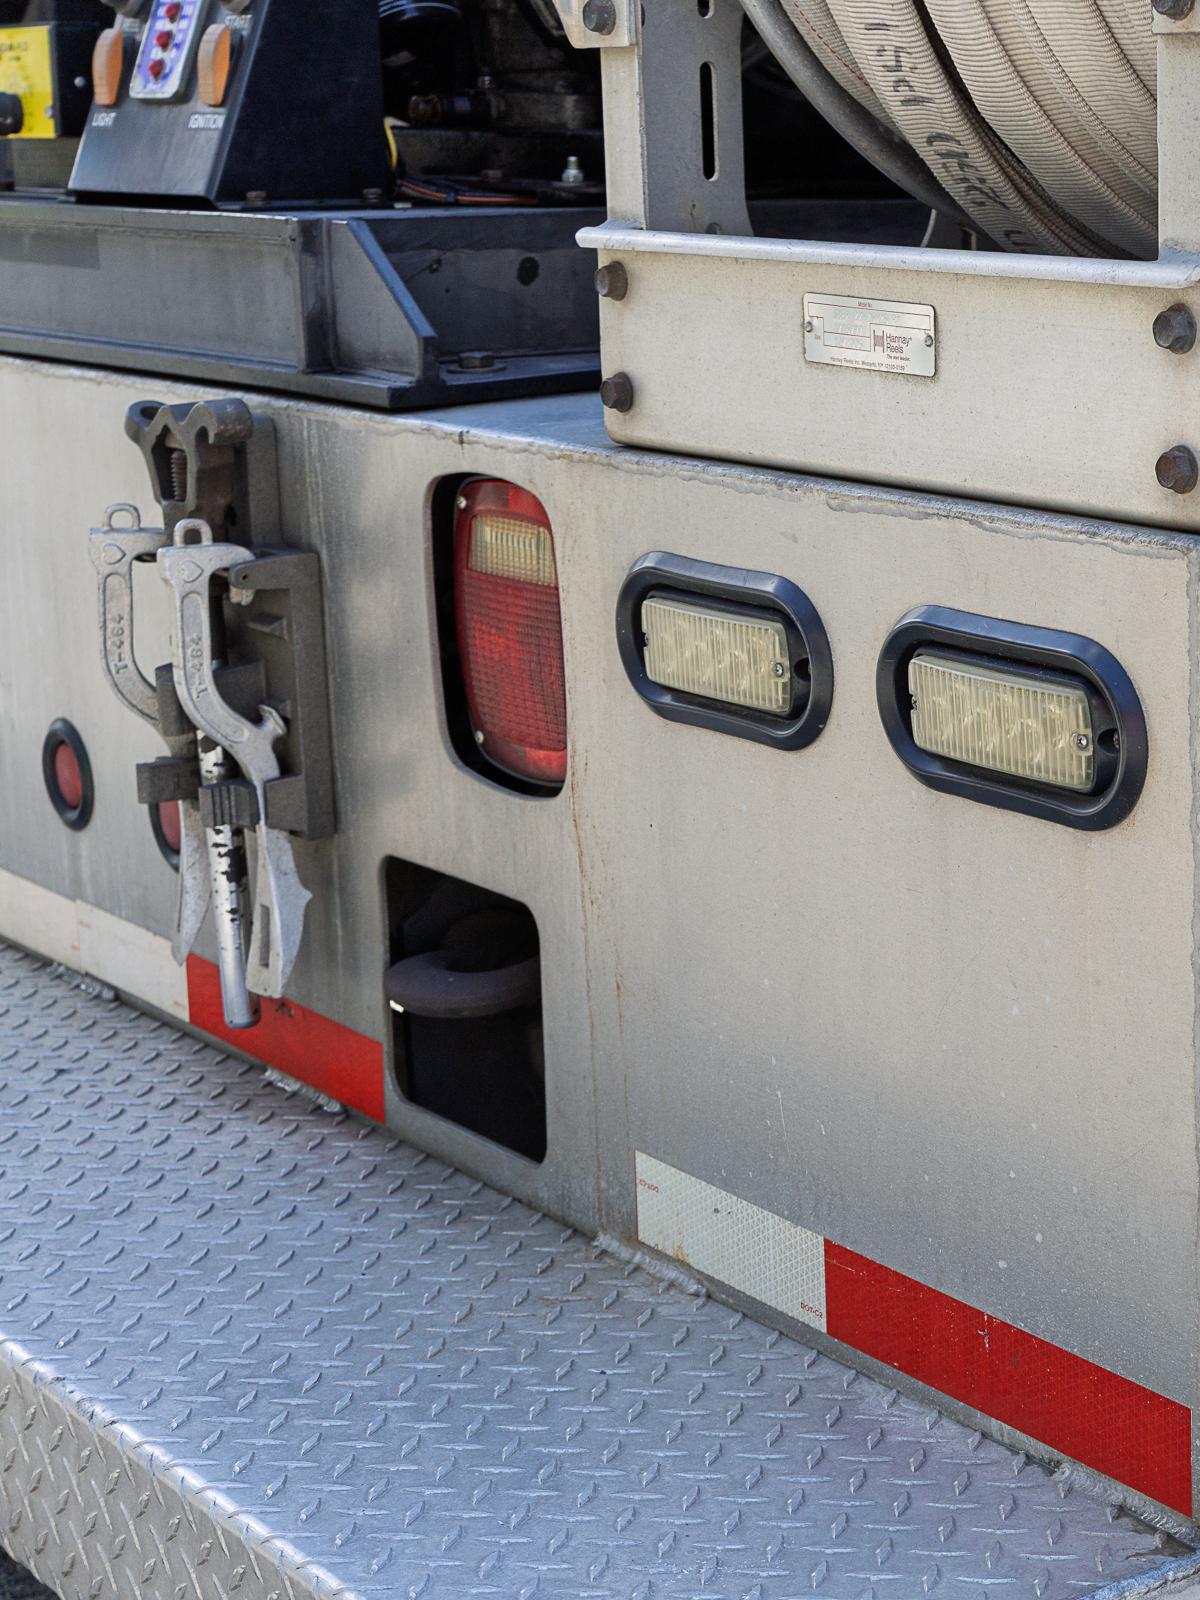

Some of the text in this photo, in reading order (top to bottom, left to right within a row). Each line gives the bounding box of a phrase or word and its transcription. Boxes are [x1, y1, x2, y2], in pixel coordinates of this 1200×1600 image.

[864, 22, 936, 107] PSI
[91, 112, 117, 127] LIGHT
[188, 114, 226, 129] IGNITION
[885, 331, 911, 346] Hannay
[885, 344, 904, 354] Reels
[109, 613, 128, 675] T-464
[189, 633, 208, 699] T-464
[800, 1302, 823, 1319] DOT-C2
